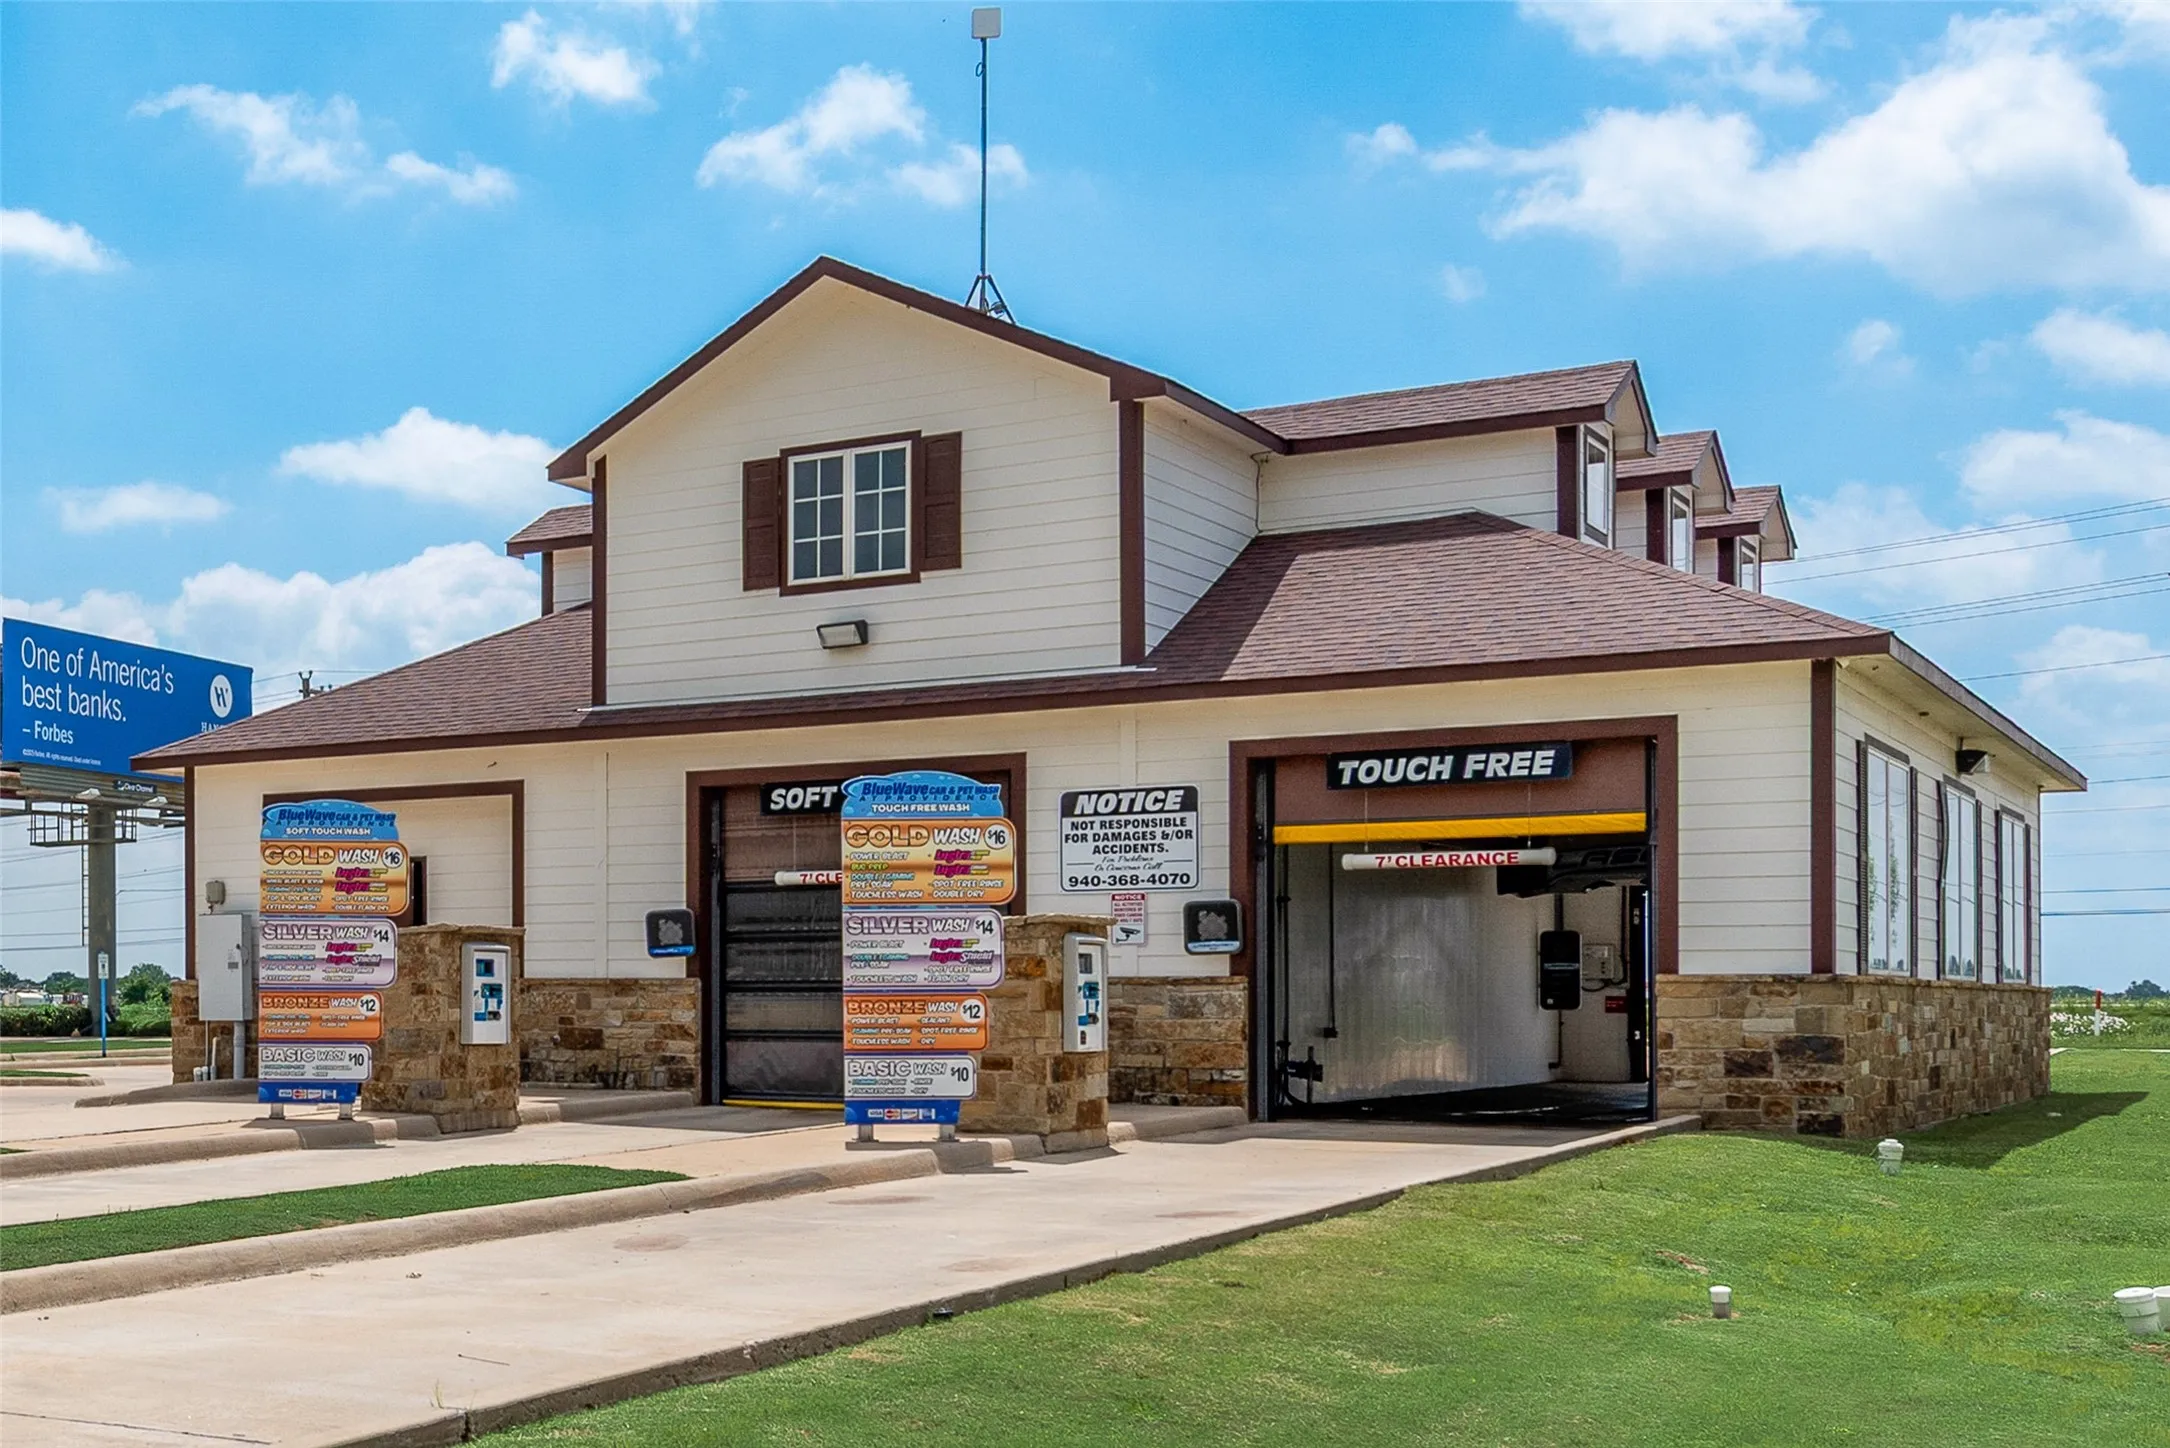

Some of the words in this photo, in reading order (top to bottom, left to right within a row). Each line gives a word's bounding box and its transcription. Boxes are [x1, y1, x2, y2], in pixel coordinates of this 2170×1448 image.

[20, 636, 61, 674] One
[65, 647, 85, 677] of
[88, 650, 175, 695] America's
[21, 675, 63, 713] best
[68, 684, 128, 722] banks.
[33, 720, 74, 745] Forbes
[1338, 754, 1454, 786] TOUCH
[1463, 749, 1556, 779] FREE
[861, 782, 930, 796] BlueWave
[929, 786, 947, 795] CAR
[956, 786, 975, 795] PET
[974, 785, 1000, 795] WASH
[769, 785, 839, 811] SOFT
[1073, 789, 1185, 816] NOTICE
[279, 808, 336, 821] BlueWave
[336, 813, 350, 821] CAR
[359, 813, 375, 821] PET
[374, 813, 397, 822] WASH
[871, 803, 910, 813] TOUCH
[910, 803, 937, 812] FREE
[938, 803, 970, 812] WASH
[285, 827, 310, 836] SOFT
[311, 827, 343, 836] TOUCH
[343, 827, 372, 836] WASH
[1070, 820, 1096, 831] NOT
[1099, 816, 1188, 831] RESPONSIBLE
[846, 824, 930, 848] GOLD
[933, 828, 982, 846] WASH
[987, 829, 1006, 845] $16
[1064, 832, 1089, 844] FOR
[1092, 830, 1157, 843] DAMAGES
[1160, 829, 1194, 842] &/OR
[262, 844, 336, 866] GOLD
[338, 848, 380, 864] WASH
[383, 849, 401, 865] $16
[850, 852, 881, 860] POWER
[882, 851, 909, 860] BLAST
[1092, 842, 1170, 855] ACCIDENTS.
[1374, 856, 1393, 869] 7'
[1395, 850, 1520, 868] CLEARANCE
[800, 873, 813, 885] 7'
[851, 872, 880, 880] DOUBLE
[932, 880, 954, 888] SPOT
[957, 880, 977, 888] FREE
[1068, 873, 1191, 888] 940-368-4070
[850, 890, 897, 899] TOUCHLESS
[898, 890, 924, 899] WASH
[932, 889, 965, 898] DOUBLE
[965, 890, 985, 898] DRY
[261, 923, 334, 941] SILVER
[334, 926, 369, 939] WASH
[373, 929, 389, 943] $14
[847, 915, 930, 935] SILVER
[931, 917, 971, 933] WASH
[975, 920, 994, 935] $14
[262, 996, 331, 1009] BRONZE
[330, 997, 359, 1008] WASH
[359, 999, 376, 1012] $12
[847, 1001, 926, 1015] BRONZE
[927, 1002, 959, 1013] WASH
[962, 1004, 981, 1019] $12
[261, 1047, 316, 1063] BASIC
[316, 1050, 346, 1062] WASH
[348, 1052, 365, 1067] $10
[848, 1060, 912, 1077] BASIC
[912, 1062, 948, 1076] WASH
[951, 1067, 970, 1082] $10
